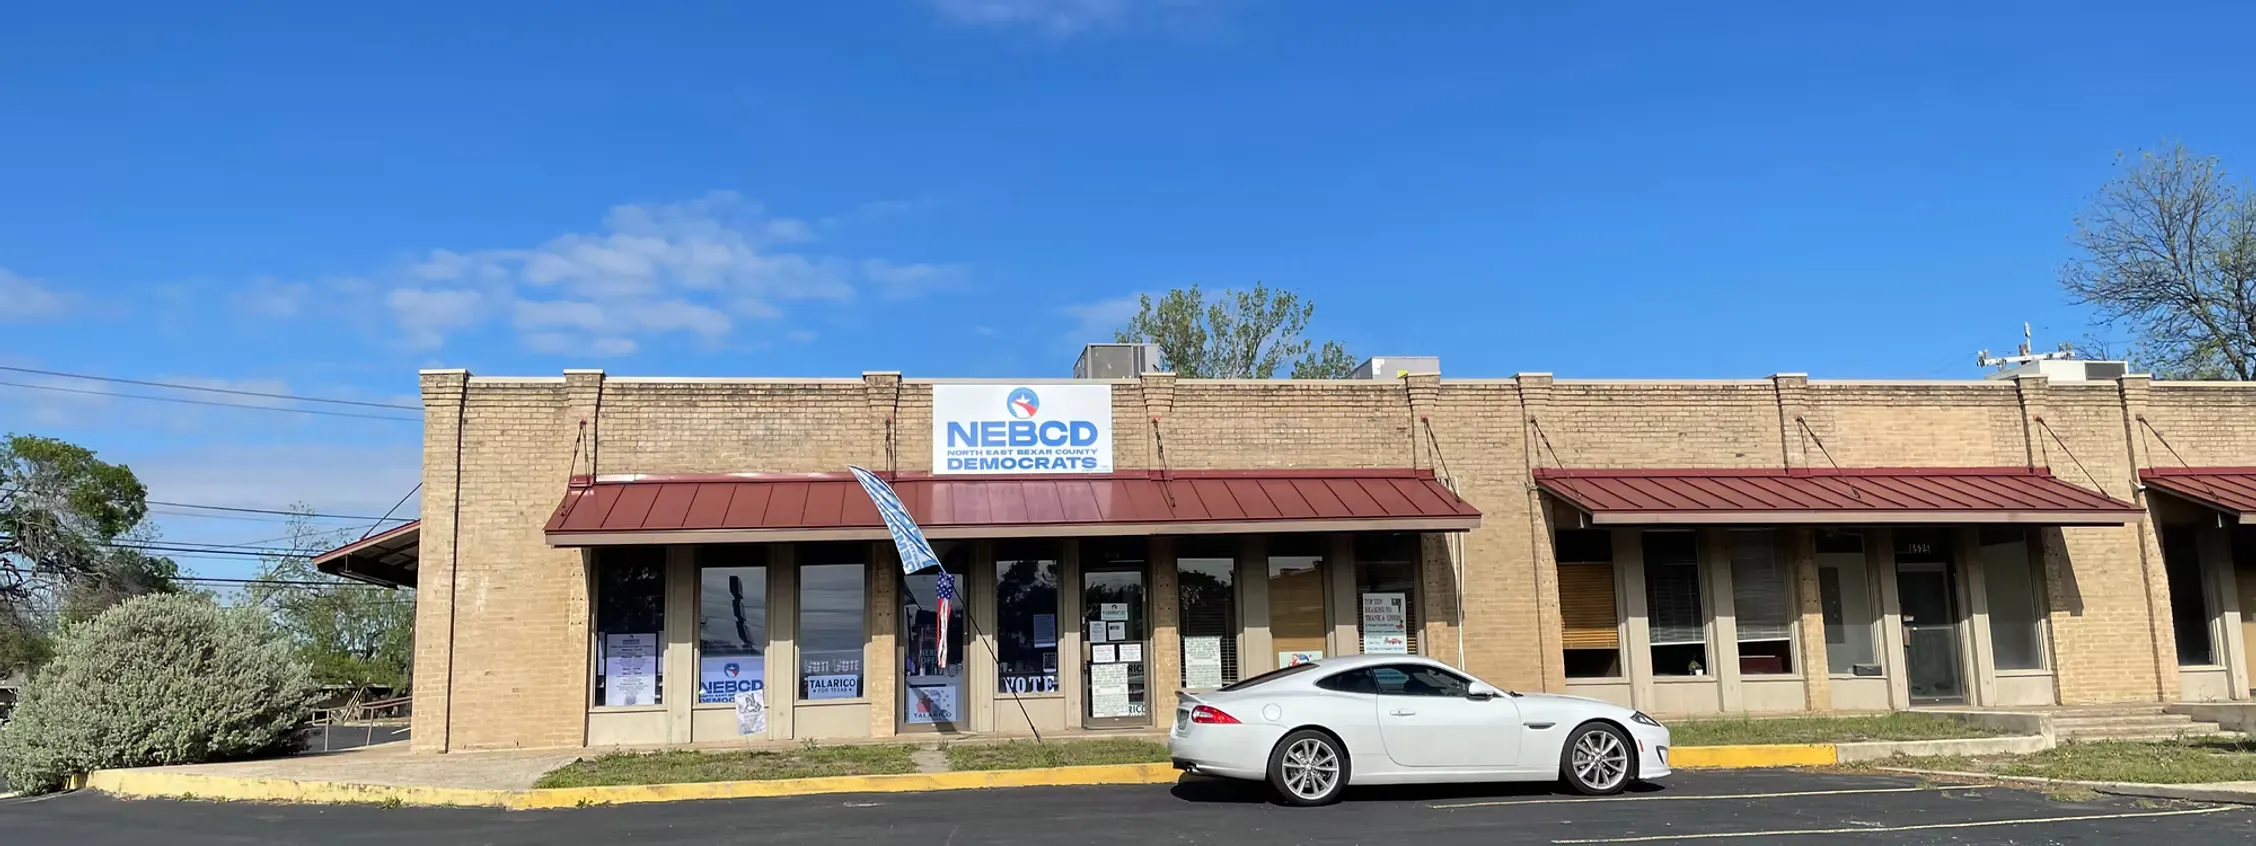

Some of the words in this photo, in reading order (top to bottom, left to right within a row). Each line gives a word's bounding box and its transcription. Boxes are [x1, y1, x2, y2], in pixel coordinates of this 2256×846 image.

[947, 420, 1098, 447] NEBCD
[947, 457, 1098, 470] DEMOCRATS
[701, 679, 764, 694] NEBCD
[810, 678, 856, 689] TALARICO
[1003, 675, 1055, 693] VOTE
[913, 711, 952, 719] TALARICO
